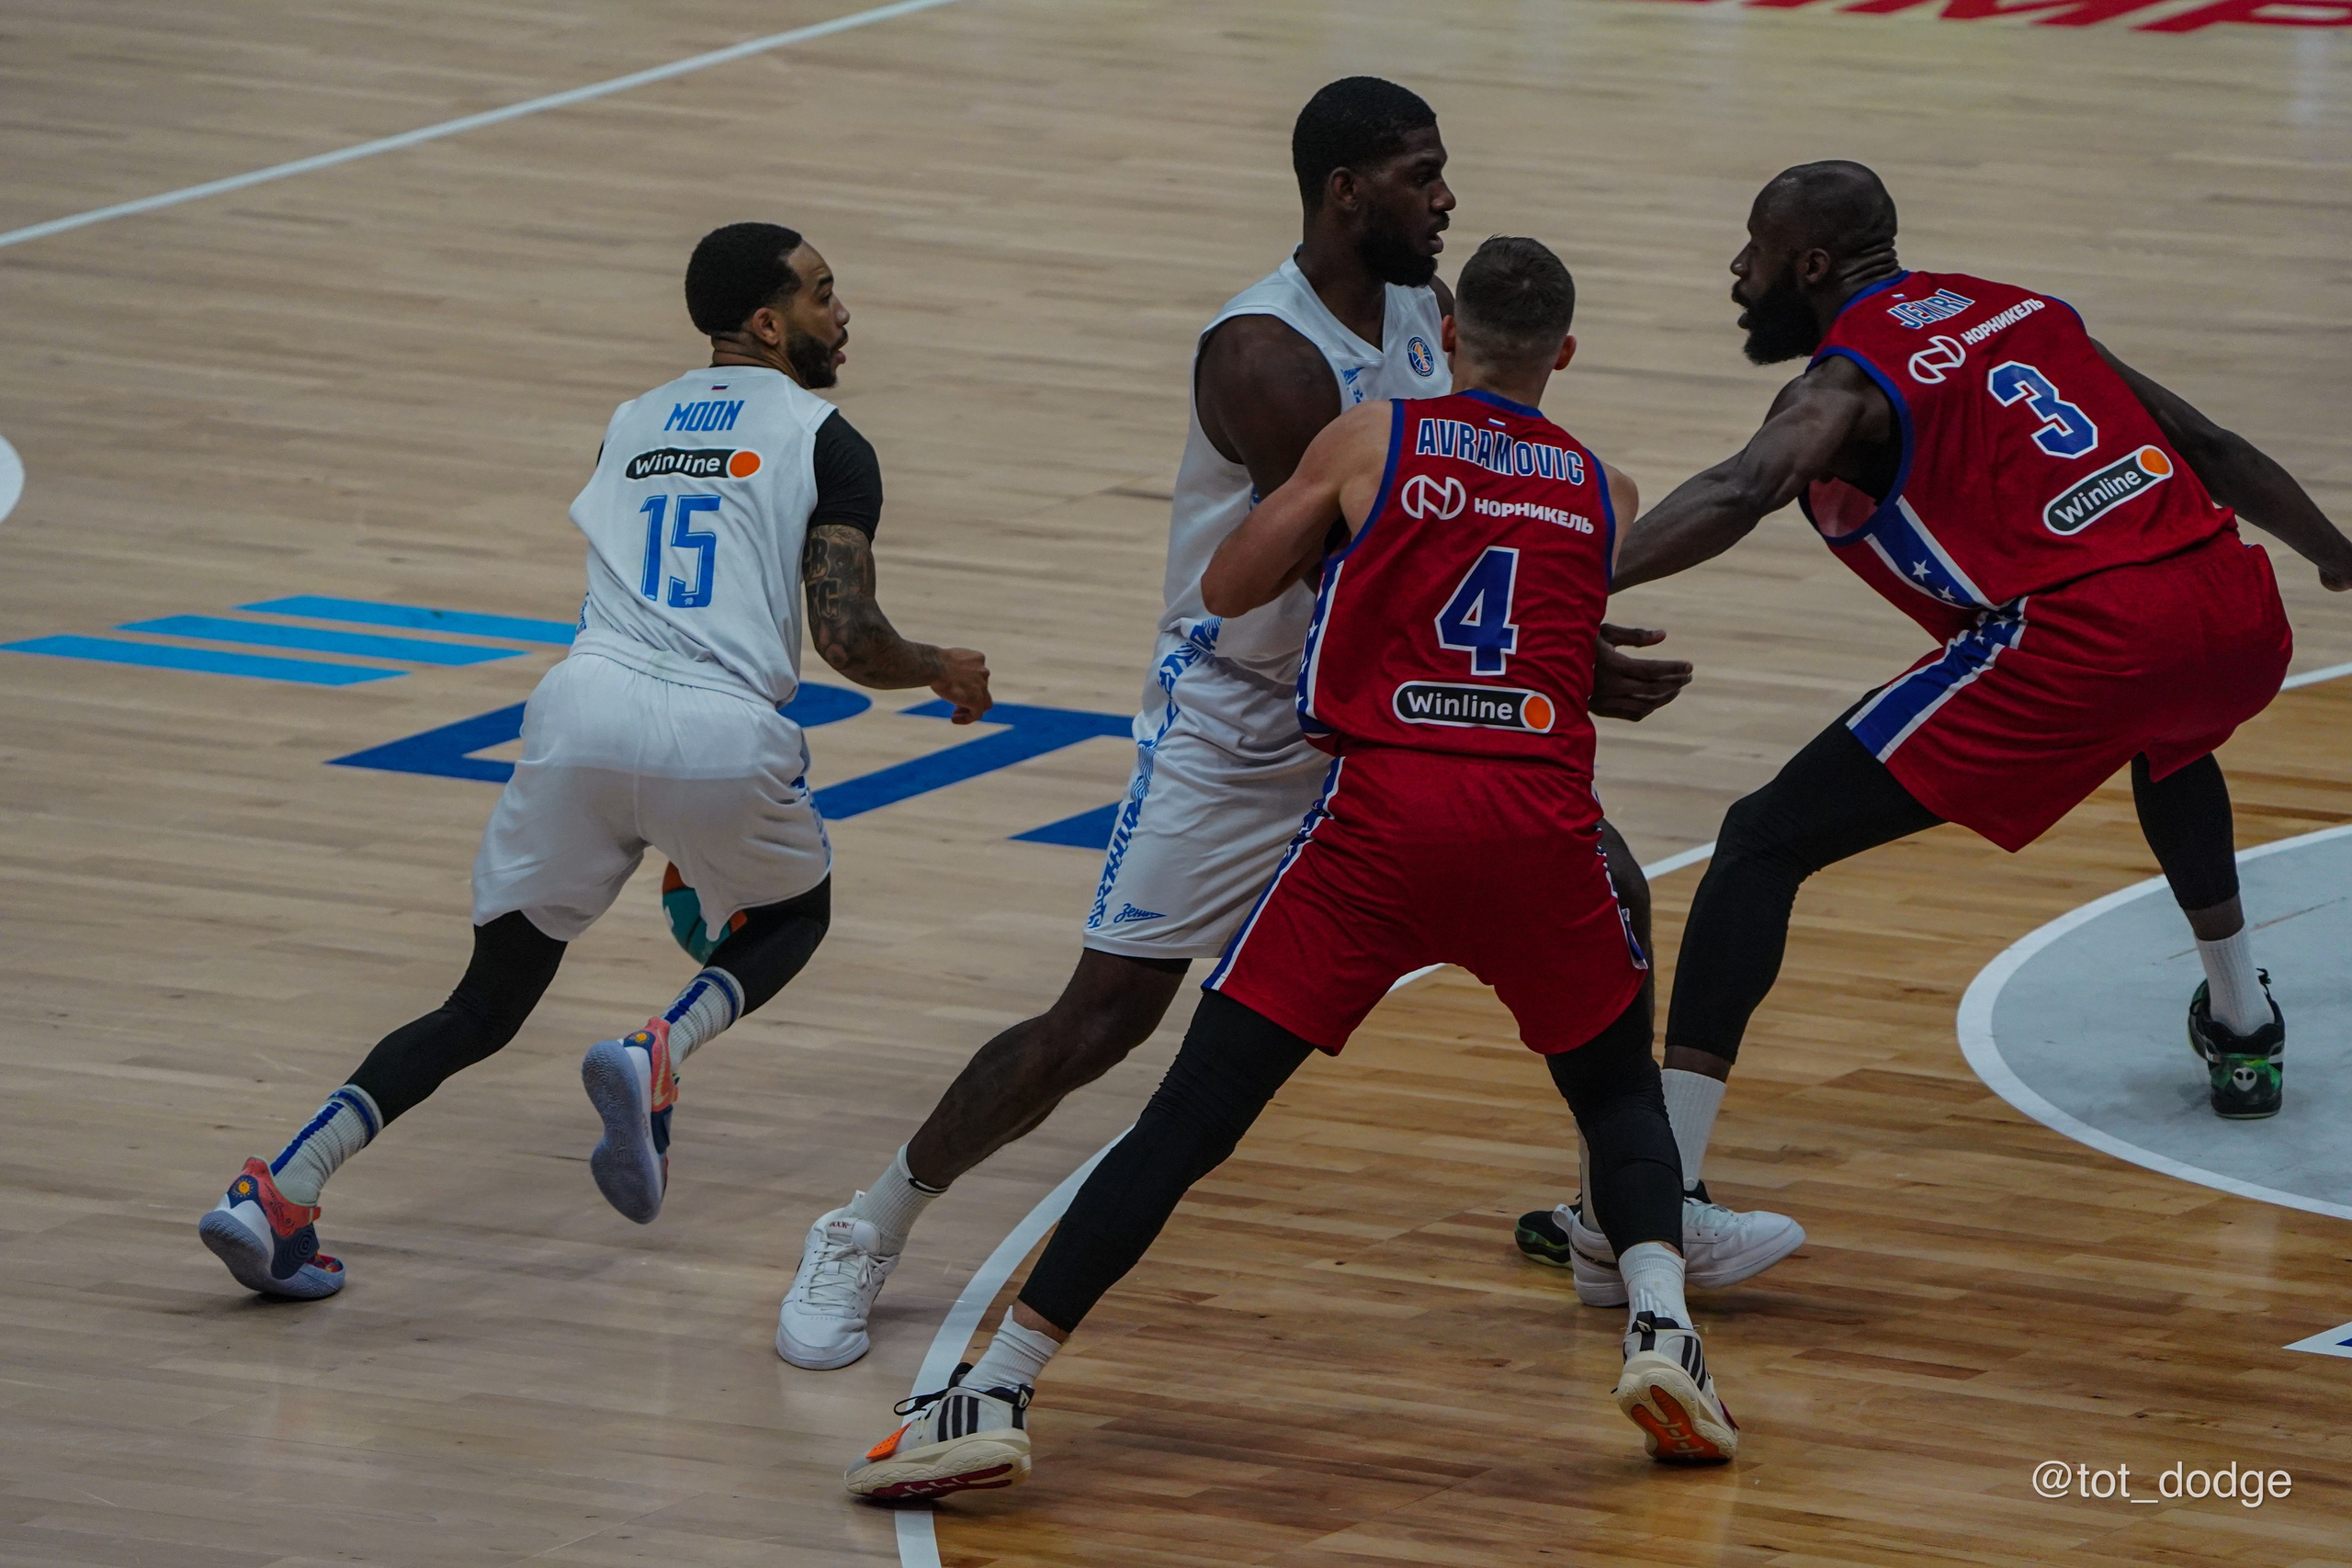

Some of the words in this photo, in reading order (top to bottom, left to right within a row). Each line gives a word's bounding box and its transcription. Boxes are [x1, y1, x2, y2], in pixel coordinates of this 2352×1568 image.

[1961, 298, 2045, 346] НОРНИКЕЛЬ
[663, 400, 745, 431] MOON
[1987, 360, 2098, 458] 3
[635, 451, 720, 476] Winline
[1416, 418, 1585, 486] AVRAMOVIC
[1474, 497, 1594, 535] НОРНИКЕЛЬ
[2054, 466, 2142, 525] Winline
[639, 494, 721, 608] 15
[1434, 545, 1520, 676] 4
[1407, 691, 1513, 720] Winline
